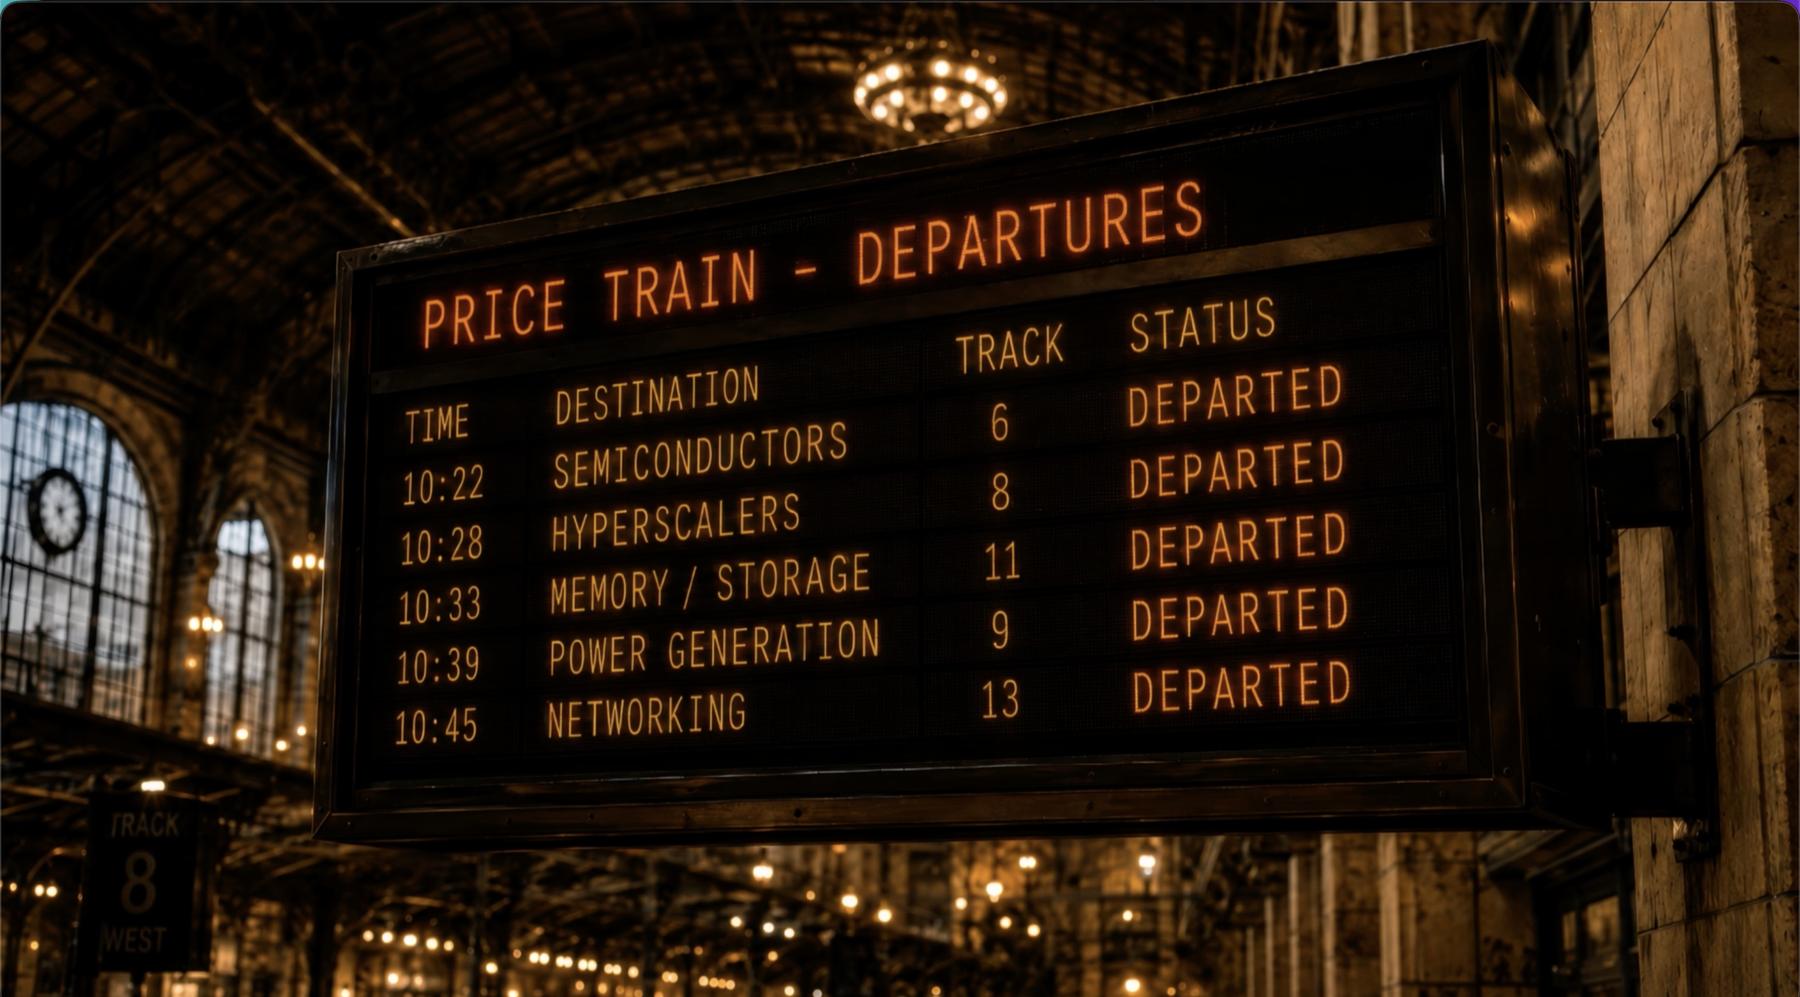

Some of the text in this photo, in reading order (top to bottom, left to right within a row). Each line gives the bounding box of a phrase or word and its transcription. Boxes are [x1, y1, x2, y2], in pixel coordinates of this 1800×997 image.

[422, 179, 1204, 350] PRICE TRAIN - DEPARTURES
[404, 295, 1277, 445] TIME DESTINATION TRACK STATUS
[402, 363, 1343, 507] 10:22 SEMICONDUCTORS 6 DEPARTED
[401, 438, 1345, 567] 10:28 HYPERSCALERS 8 DEPARTED
[398, 511, 1347, 626] 10:33 MEMORY / STORAGE 11 DEPARTED
[397, 585, 1349, 686] 10:39 POWER GENERATION 9 DEPARTED
[395, 659, 1352, 746] 10:45 NETWORKING 13 DEPARTED
[111, 811, 179, 838] TRACK
[121, 850, 157, 914] 8
[102, 925, 168, 953] WEST
